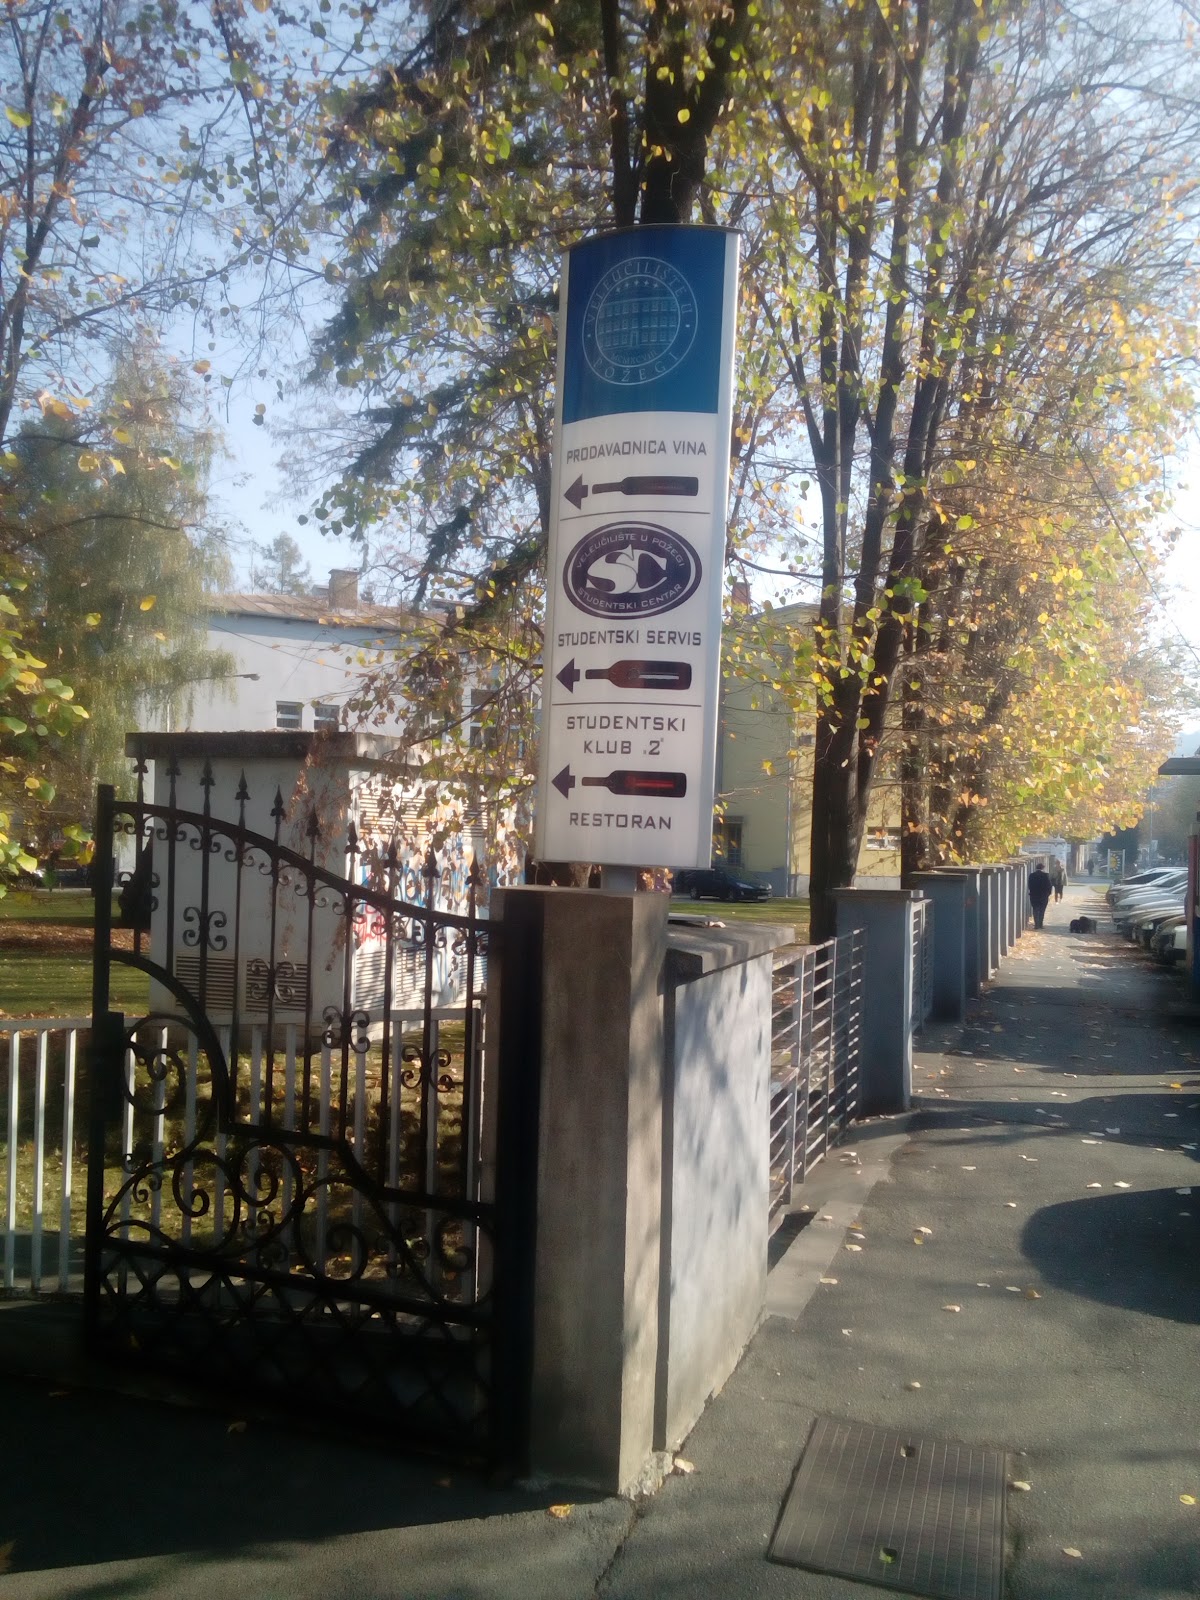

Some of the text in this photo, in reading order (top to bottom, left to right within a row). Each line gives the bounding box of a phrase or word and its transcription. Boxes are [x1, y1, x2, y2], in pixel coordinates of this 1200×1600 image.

[586, 261, 688, 323] VELEUČILIŠTE
[593, 351, 680, 382] POŽEGI
[566, 440, 707, 464] PRODAVAONICA VINA
[576, 533, 637, 568] VELEUČILIŠTE
[651, 536, 685, 567] POŽEGI
[578, 582, 683, 610] STUDENTSKI CENTAR
[558, 629, 702, 647] STUDENTSKI SERVIS
[566, 715, 686, 732] STUDENTSKI
[583, 740, 632, 755] KLUB
[569, 812, 672, 830] RESTORAN
